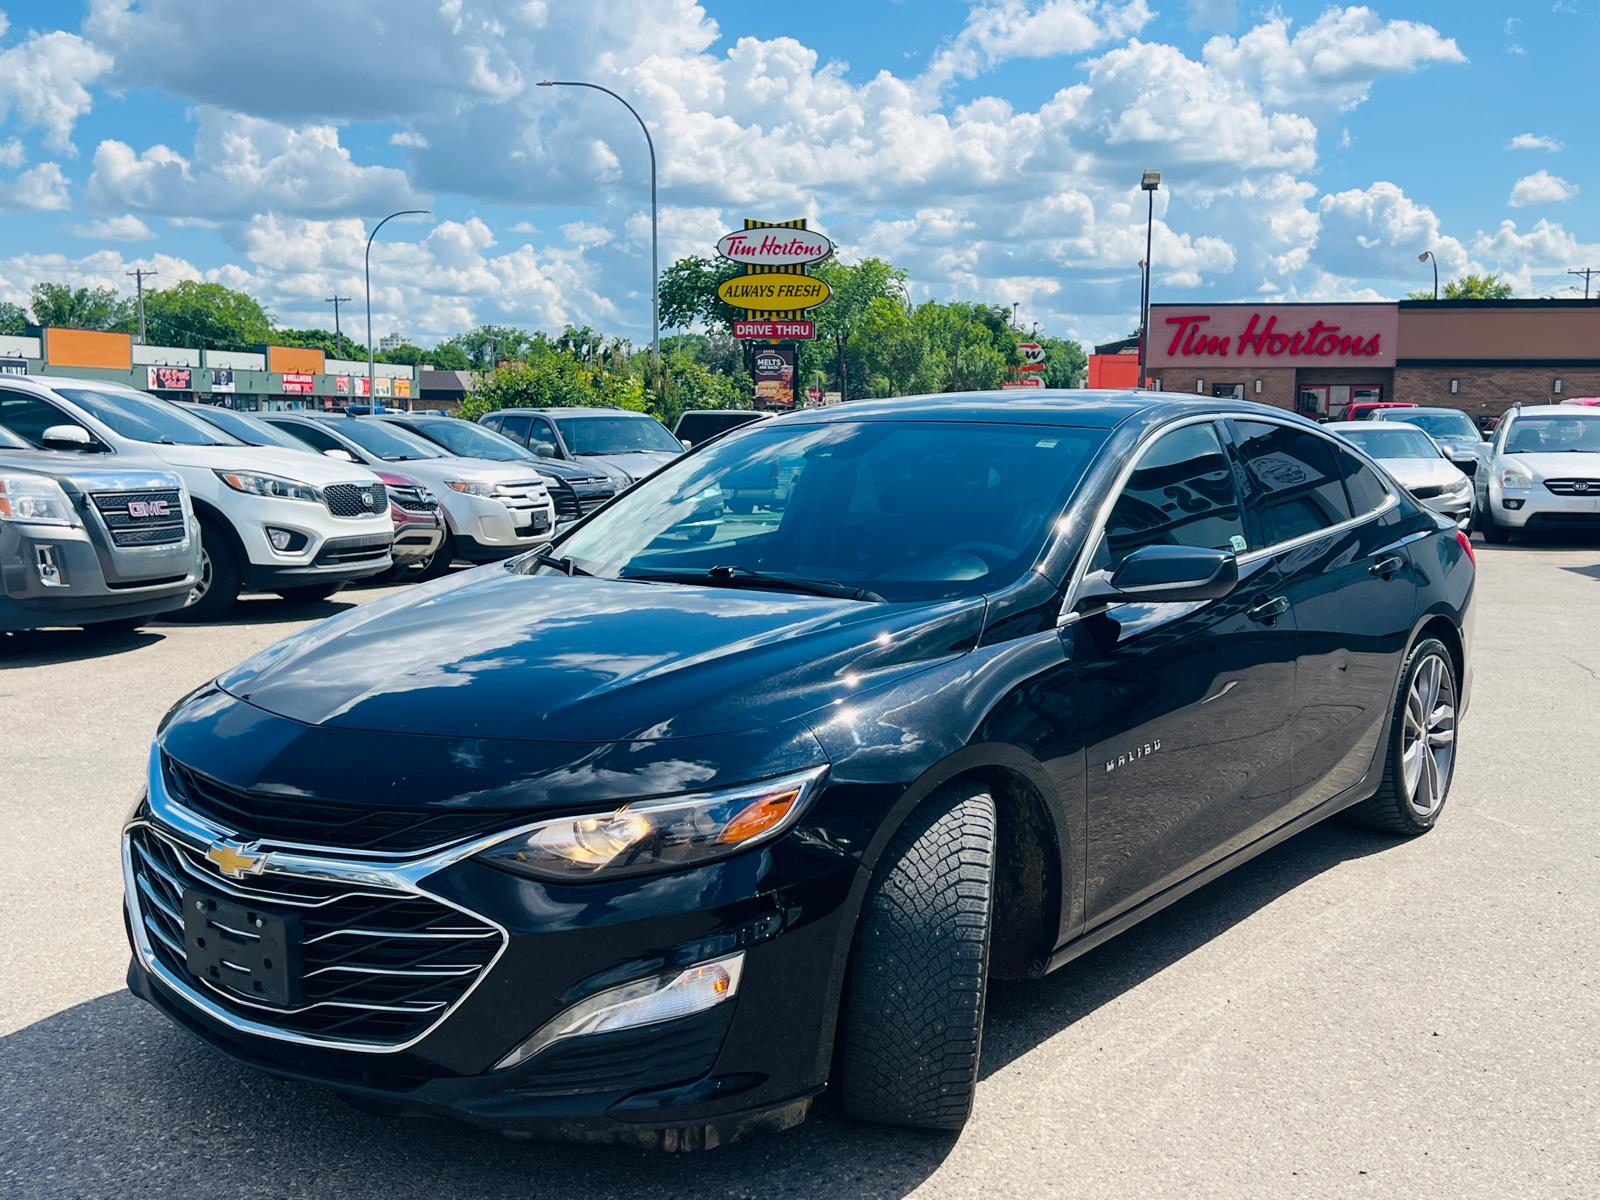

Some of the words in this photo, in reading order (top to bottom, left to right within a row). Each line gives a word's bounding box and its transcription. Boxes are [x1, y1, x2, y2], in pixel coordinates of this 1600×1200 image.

[726, 236, 757, 257] Tim
[759, 235, 822, 256] Hortons
[724, 285, 775, 298] ALWAYS
[777, 285, 822, 297] FRESH
[736, 324, 773, 336] DRIVE
[776, 324, 809, 336] THRU
[1165, 315, 1231, 357] Tim
[1236, 313, 1381, 357] Hortons
[128, 500, 170, 518] GMC
[1105, 740, 1161, 772] MALIBU
